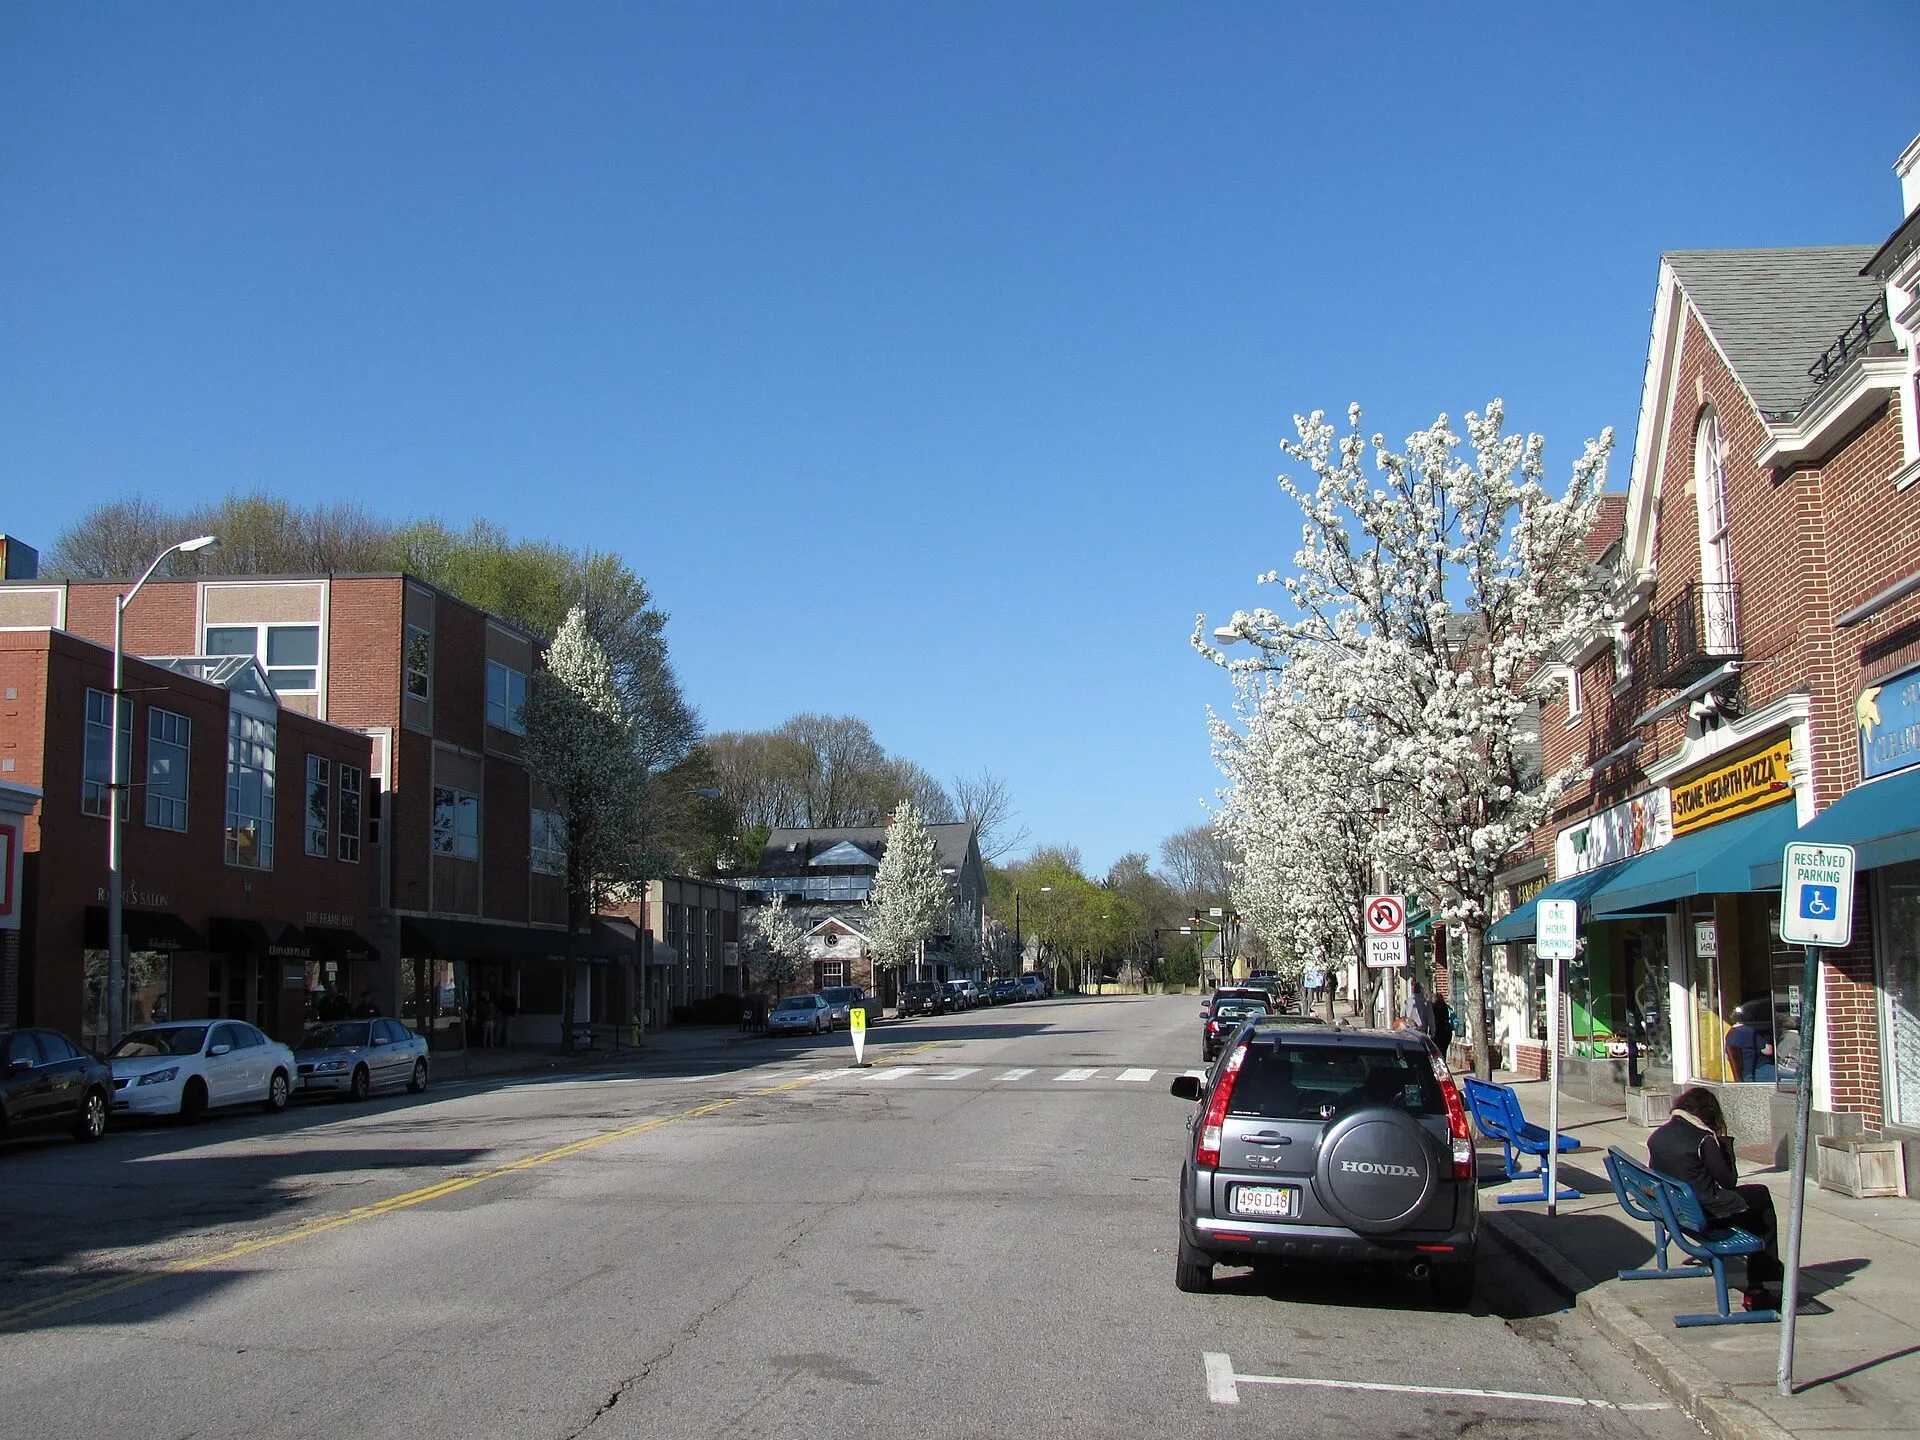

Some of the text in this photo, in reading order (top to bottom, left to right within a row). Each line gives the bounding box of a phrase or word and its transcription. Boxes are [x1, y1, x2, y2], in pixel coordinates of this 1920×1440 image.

[1676, 784, 1704, 816] STONE
[1704, 768, 1742, 805] HEARTH
[1743, 755, 1776, 791] PIZZA
[1794, 853, 1845, 868] RESERVED
[1797, 868, 1840, 883] PARKING
[305, 911, 319, 923] THE
[1548, 910, 1564, 920] ONE
[1545, 924, 1567, 934] HOUR
[1372, 941, 1400, 951] NO U
[1540, 939, 1573, 949] PARKING
[1373, 952, 1401, 962] TURN
[1340, 1160, 1420, 1178] HONDA
